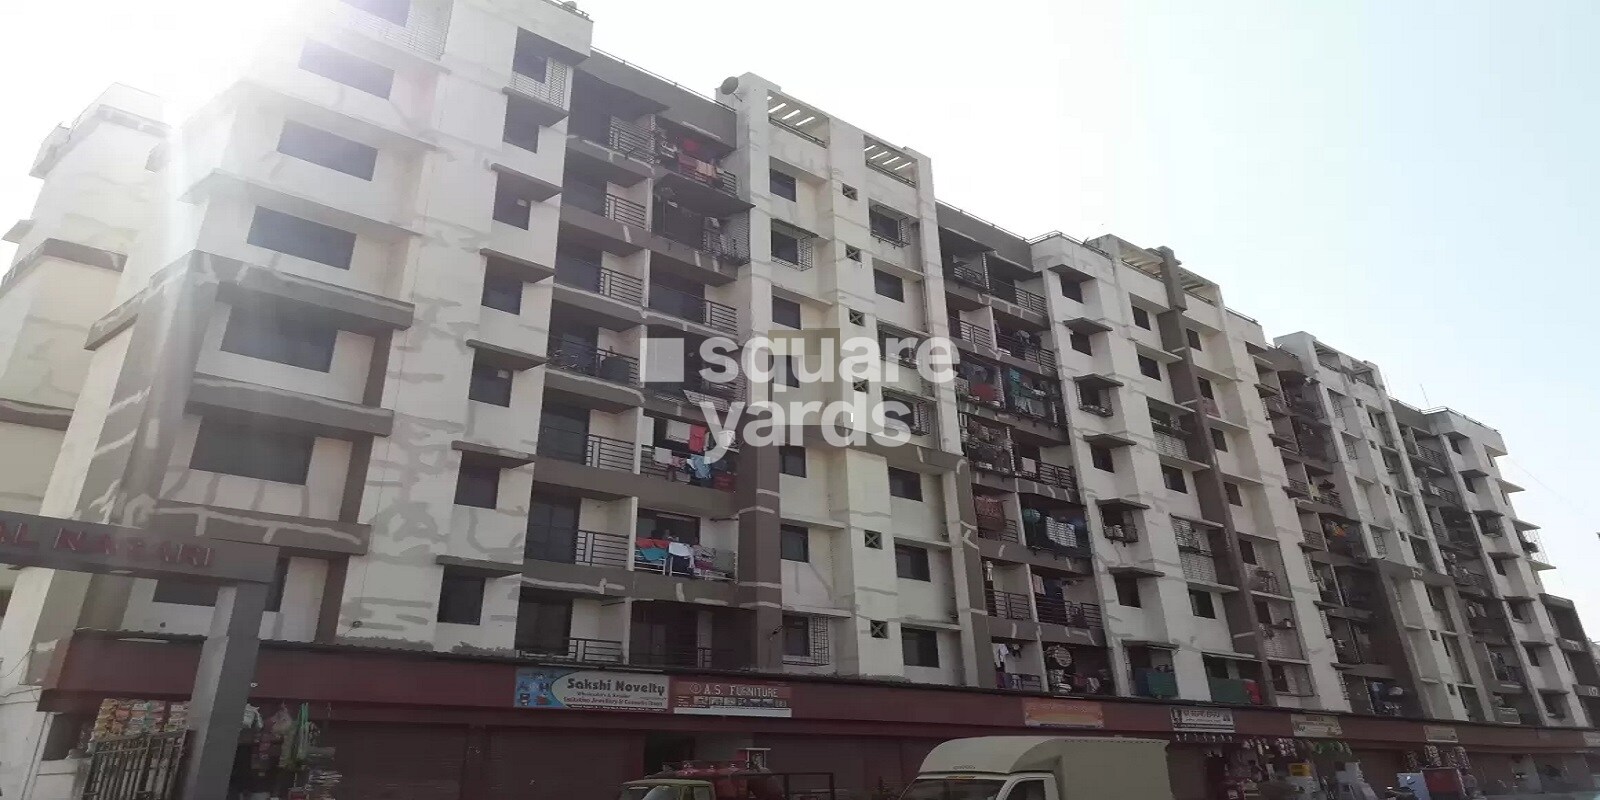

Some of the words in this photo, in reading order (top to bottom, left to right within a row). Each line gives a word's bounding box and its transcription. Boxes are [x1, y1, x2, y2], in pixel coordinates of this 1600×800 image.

[567, 678, 612, 691] Sakshi
[615, 680, 665, 696] Novelty
[730, 685, 778, 698] FURNITURE
